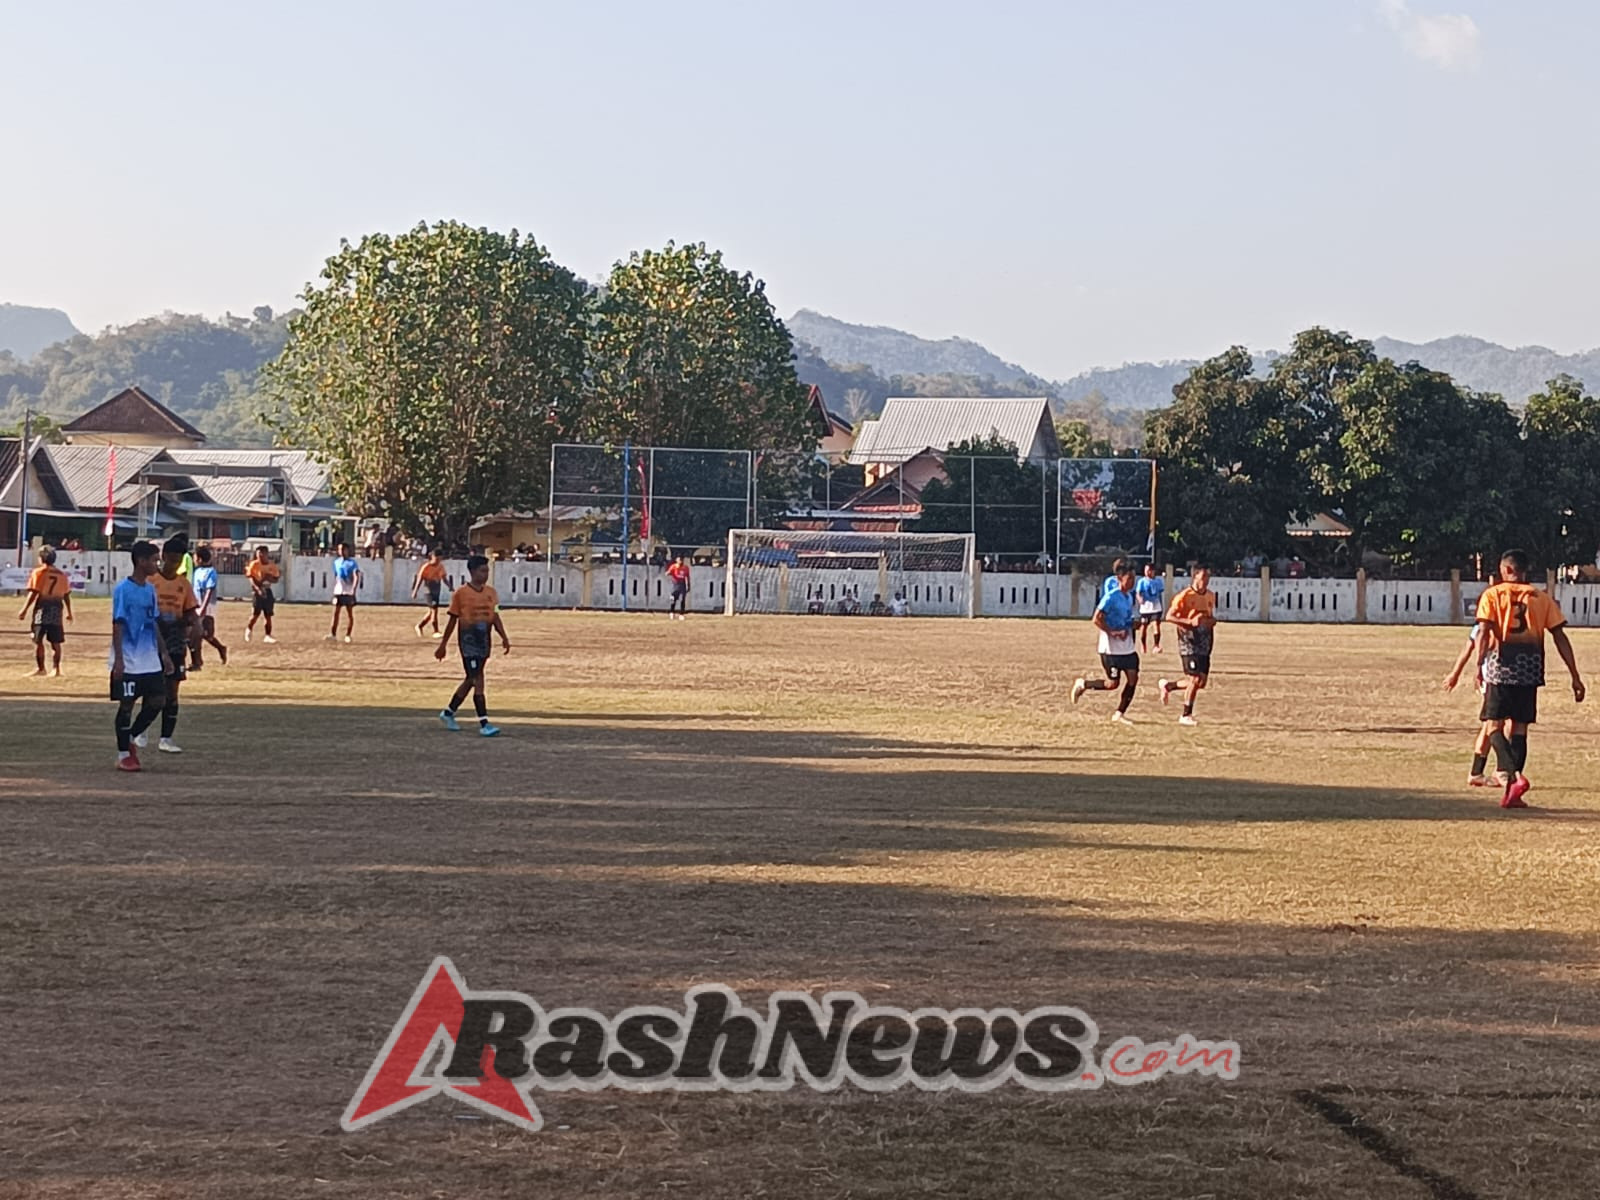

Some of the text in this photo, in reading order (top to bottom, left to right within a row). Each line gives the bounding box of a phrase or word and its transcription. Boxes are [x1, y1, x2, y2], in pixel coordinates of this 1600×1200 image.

[48, 575, 58, 595] 7
[1509, 601, 1528, 634] 3
[122, 681, 136, 697] 10
